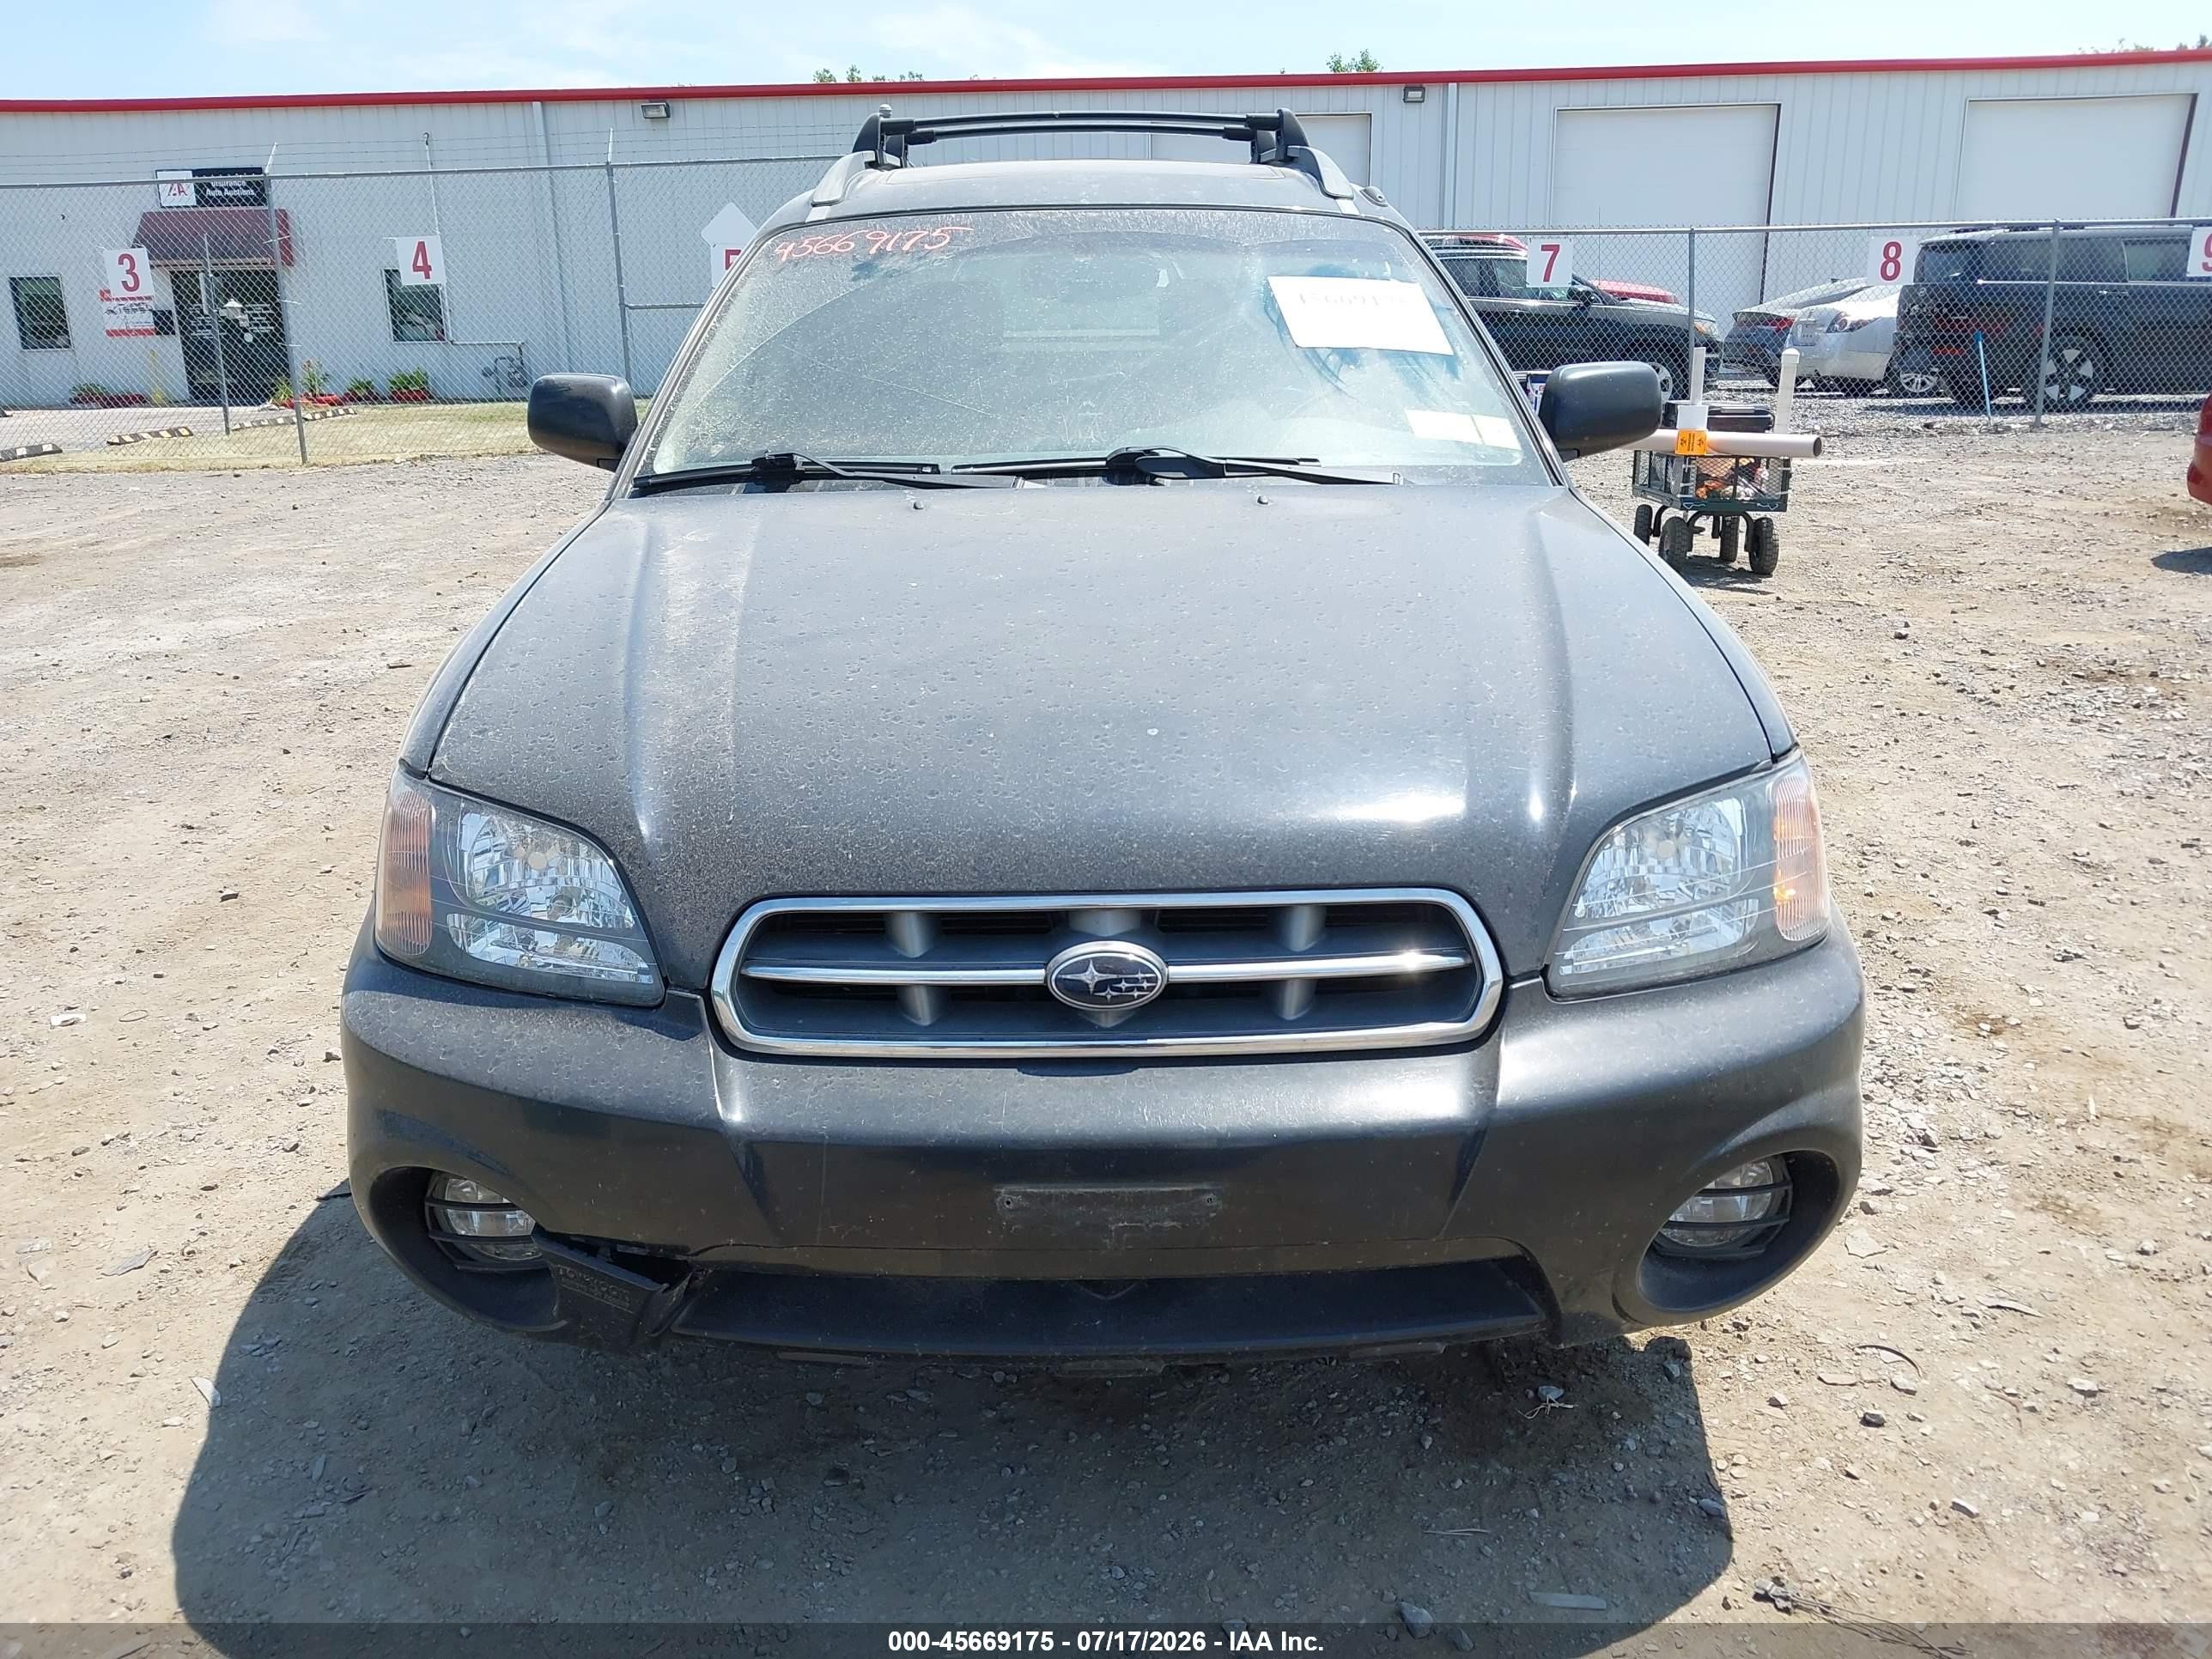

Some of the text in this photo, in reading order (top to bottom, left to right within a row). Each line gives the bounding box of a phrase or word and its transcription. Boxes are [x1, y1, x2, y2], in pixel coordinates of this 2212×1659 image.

[206, 188, 222, 197] Auto
[118, 252, 140, 292] 3
[412, 240, 433, 280] 4
[1540, 244, 1560, 283] 7
[1881, 241, 1902, 282] 8
